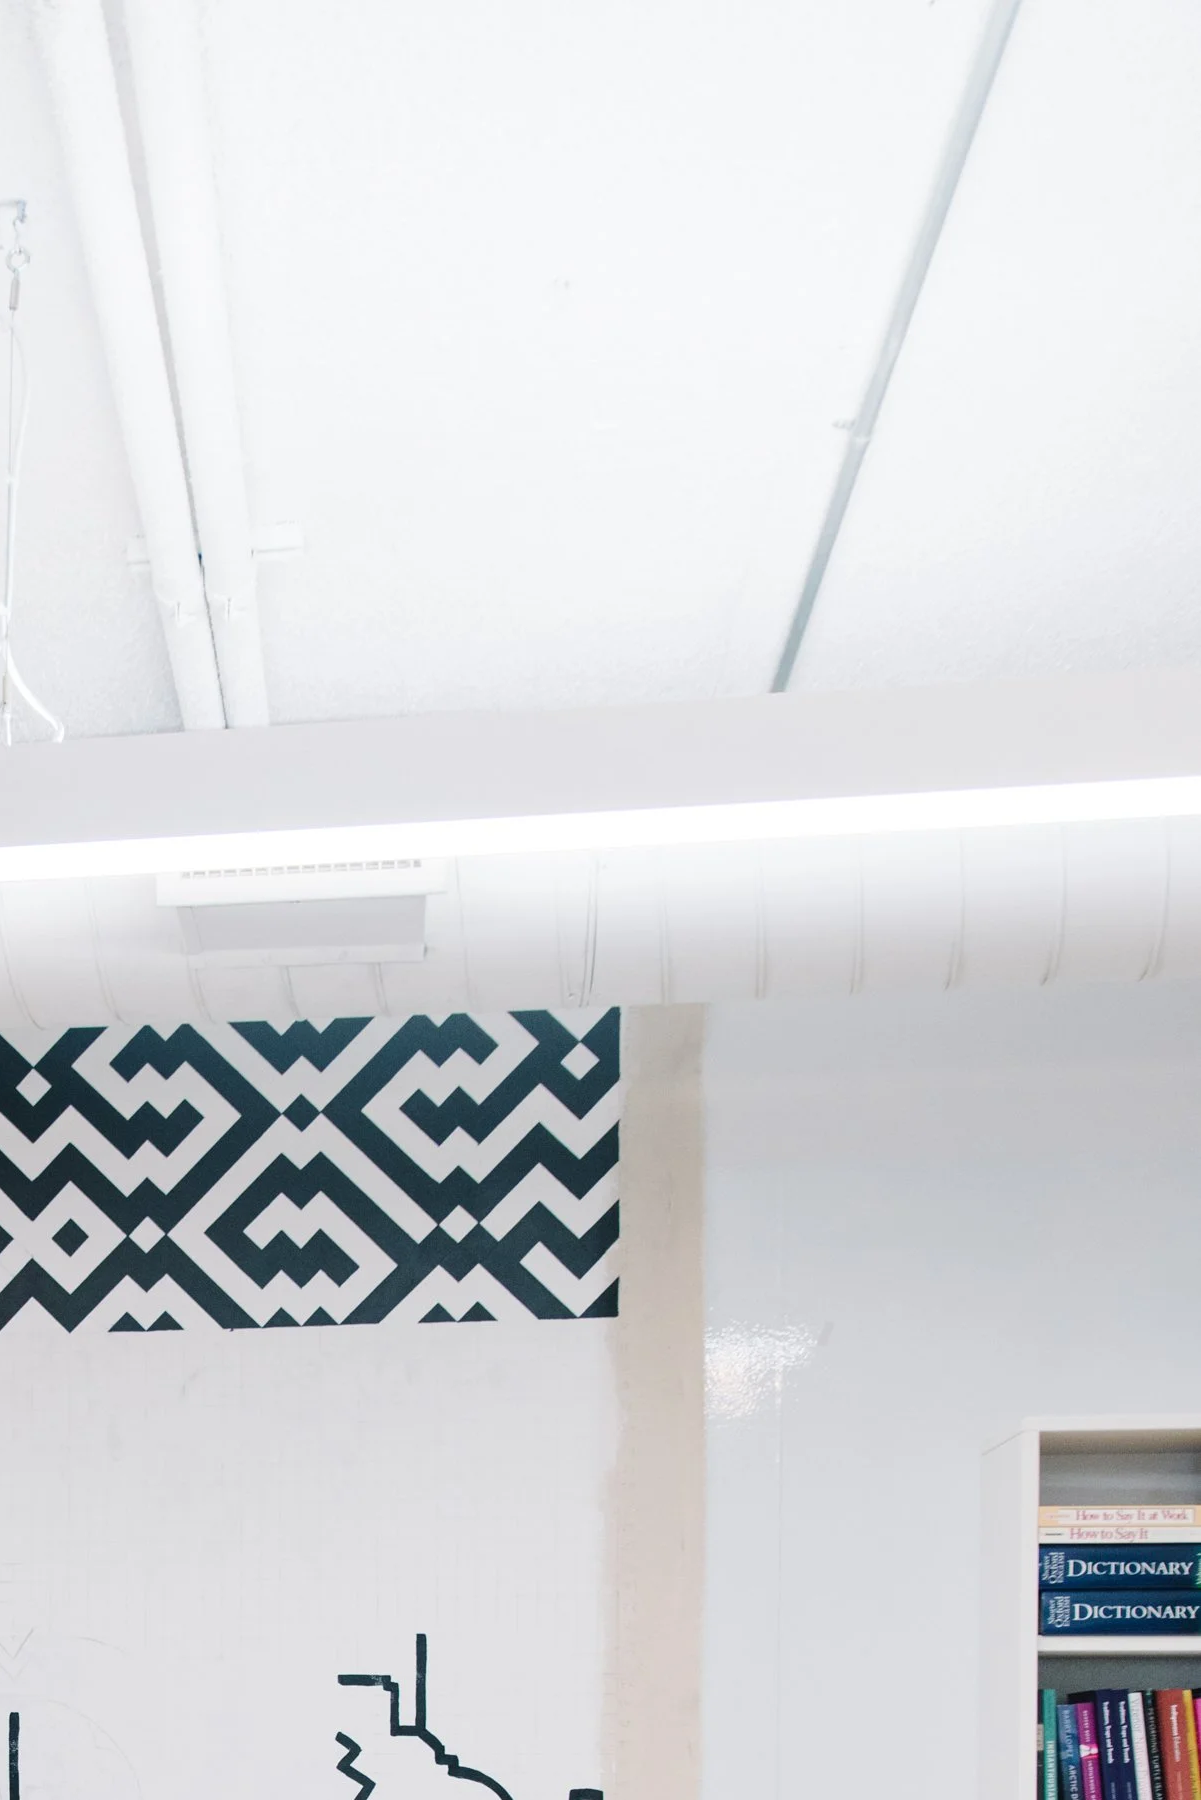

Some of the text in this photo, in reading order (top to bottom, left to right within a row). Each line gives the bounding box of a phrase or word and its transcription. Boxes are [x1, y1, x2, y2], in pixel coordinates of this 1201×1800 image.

[1069, 1528, 1149, 1543] How to Say It
[1066, 1559, 1194, 1577] DICTIONARY
[1072, 1603, 1200, 1621] DICTIONARY
[1068, 1765, 1077, 1792] ARCTIC
